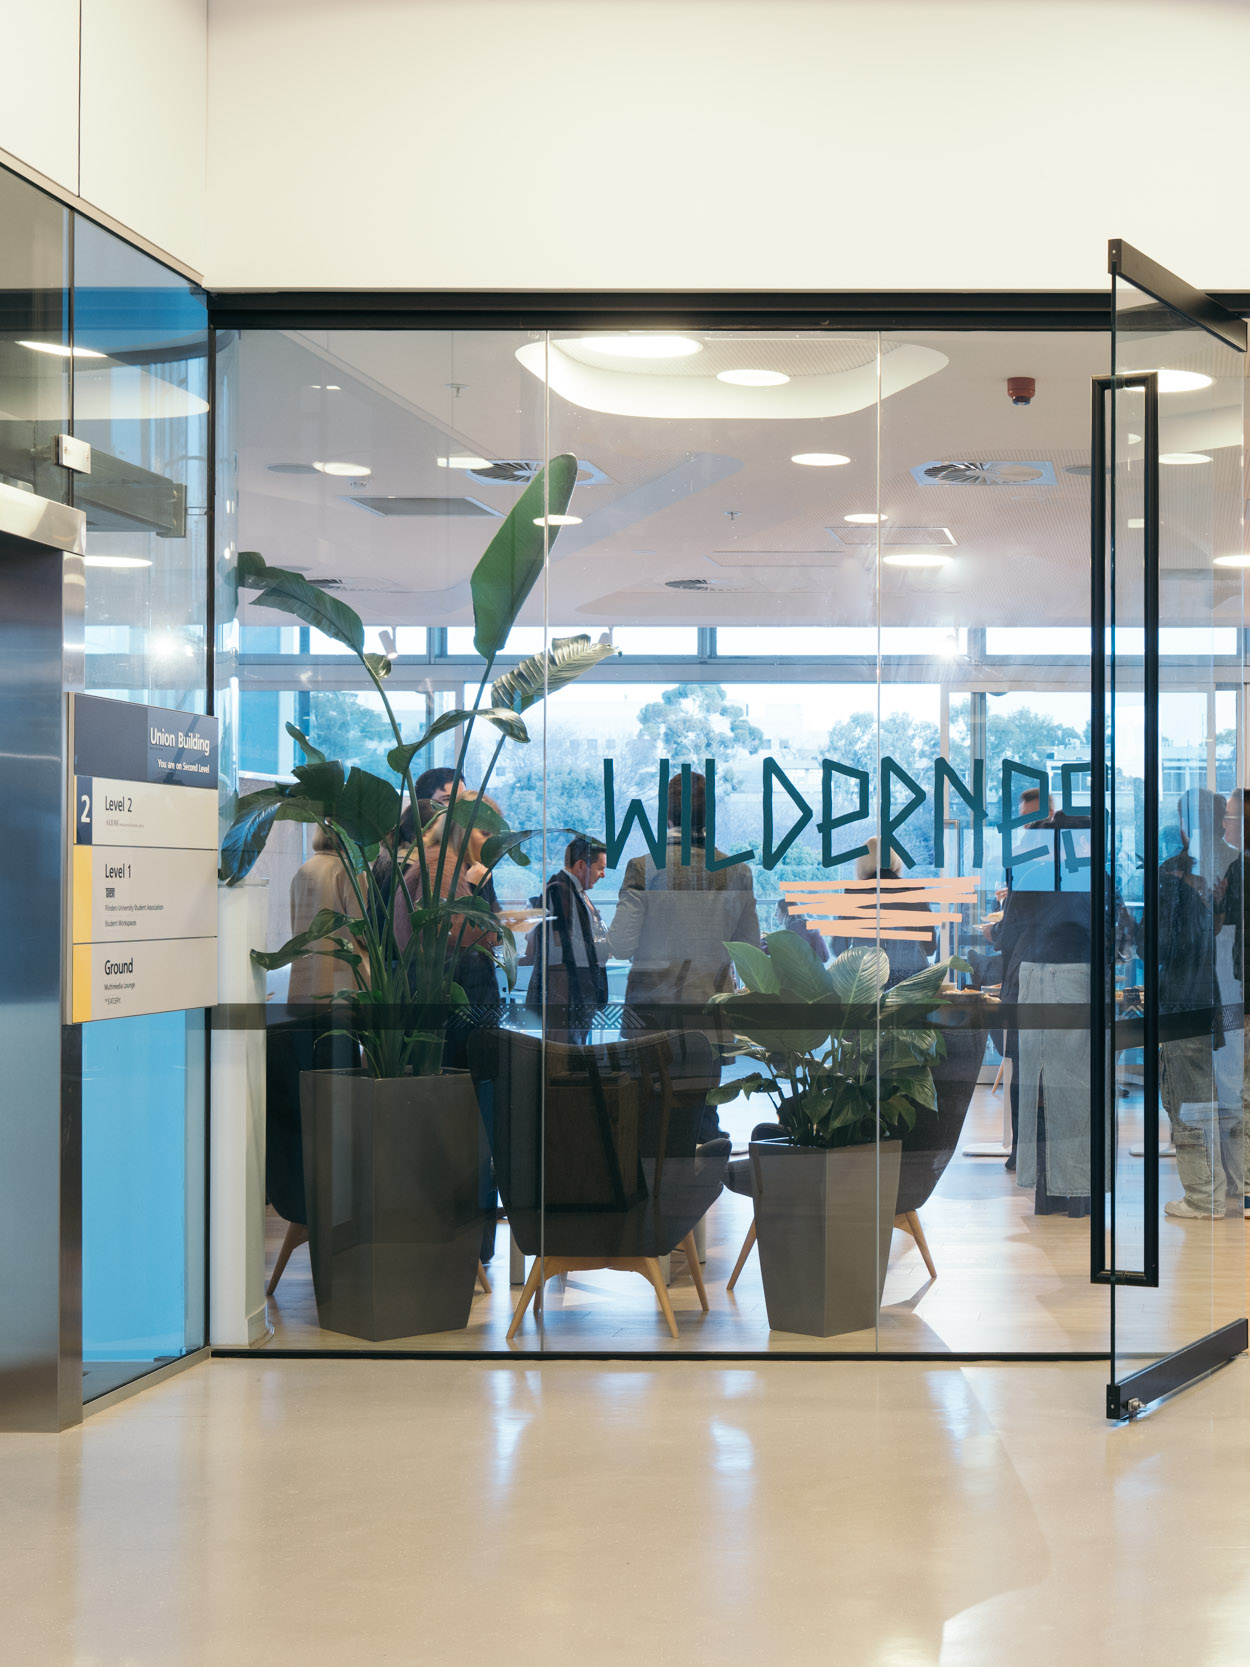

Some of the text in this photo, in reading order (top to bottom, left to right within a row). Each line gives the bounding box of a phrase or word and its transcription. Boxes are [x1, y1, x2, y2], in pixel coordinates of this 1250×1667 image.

[150, 727, 209, 756] Union Building
[158, 759, 166, 768] You
[167, 761, 175, 769] are
[183, 762, 198, 772] Second
[199, 764, 210, 773] Level
[81, 795, 91, 823] 2
[105, 796, 133, 813] Level 2
[105, 863, 132, 879] Level 1
[134, 903, 146, 911] Student
[104, 957, 134, 976] Ground
